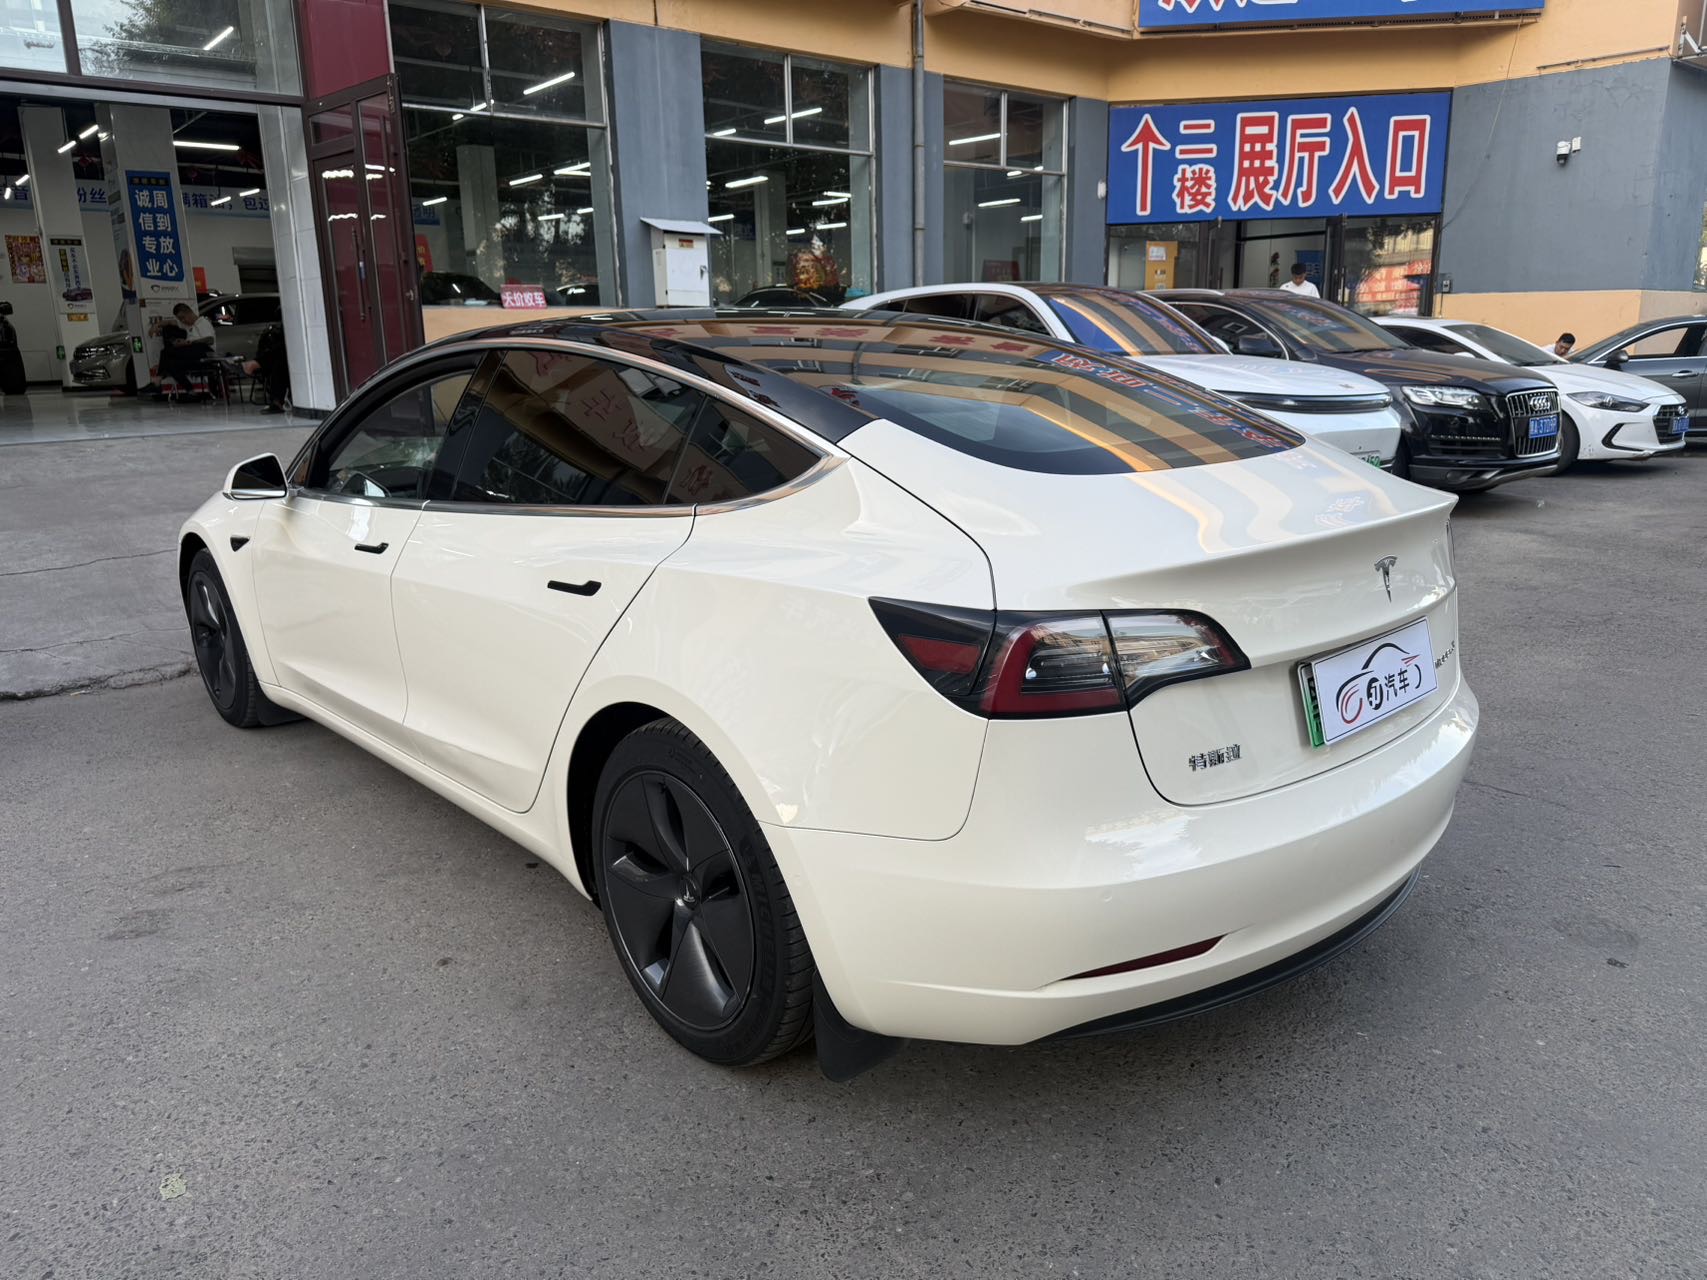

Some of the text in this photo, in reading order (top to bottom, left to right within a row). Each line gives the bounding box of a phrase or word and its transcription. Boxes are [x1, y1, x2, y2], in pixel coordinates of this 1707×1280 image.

[1173, 107, 1431, 213] 二楼 展厅入口
